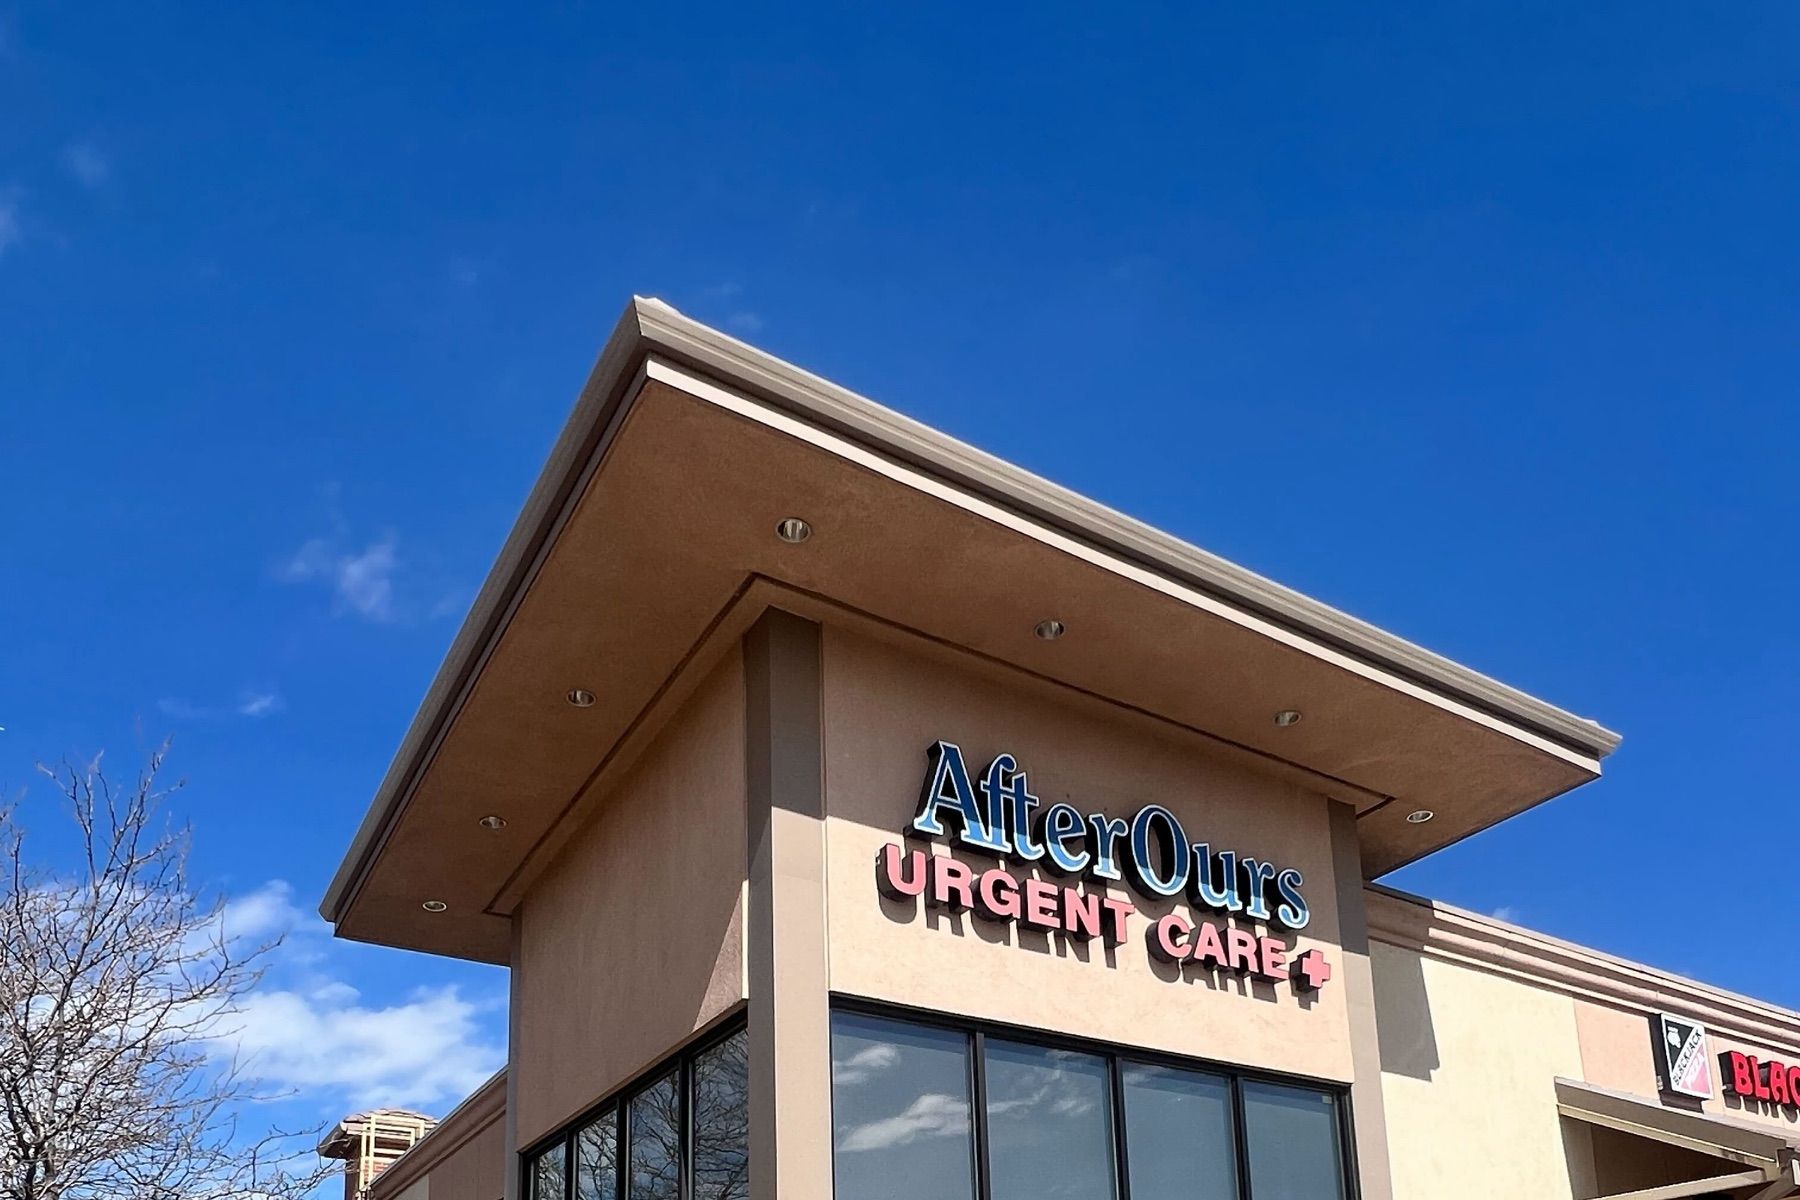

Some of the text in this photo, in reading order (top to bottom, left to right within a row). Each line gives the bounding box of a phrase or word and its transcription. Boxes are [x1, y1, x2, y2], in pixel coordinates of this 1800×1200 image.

[882, 842, 1290, 979] URGENT CARE
[1672, 1029, 1702, 1086] BLACKJACK
